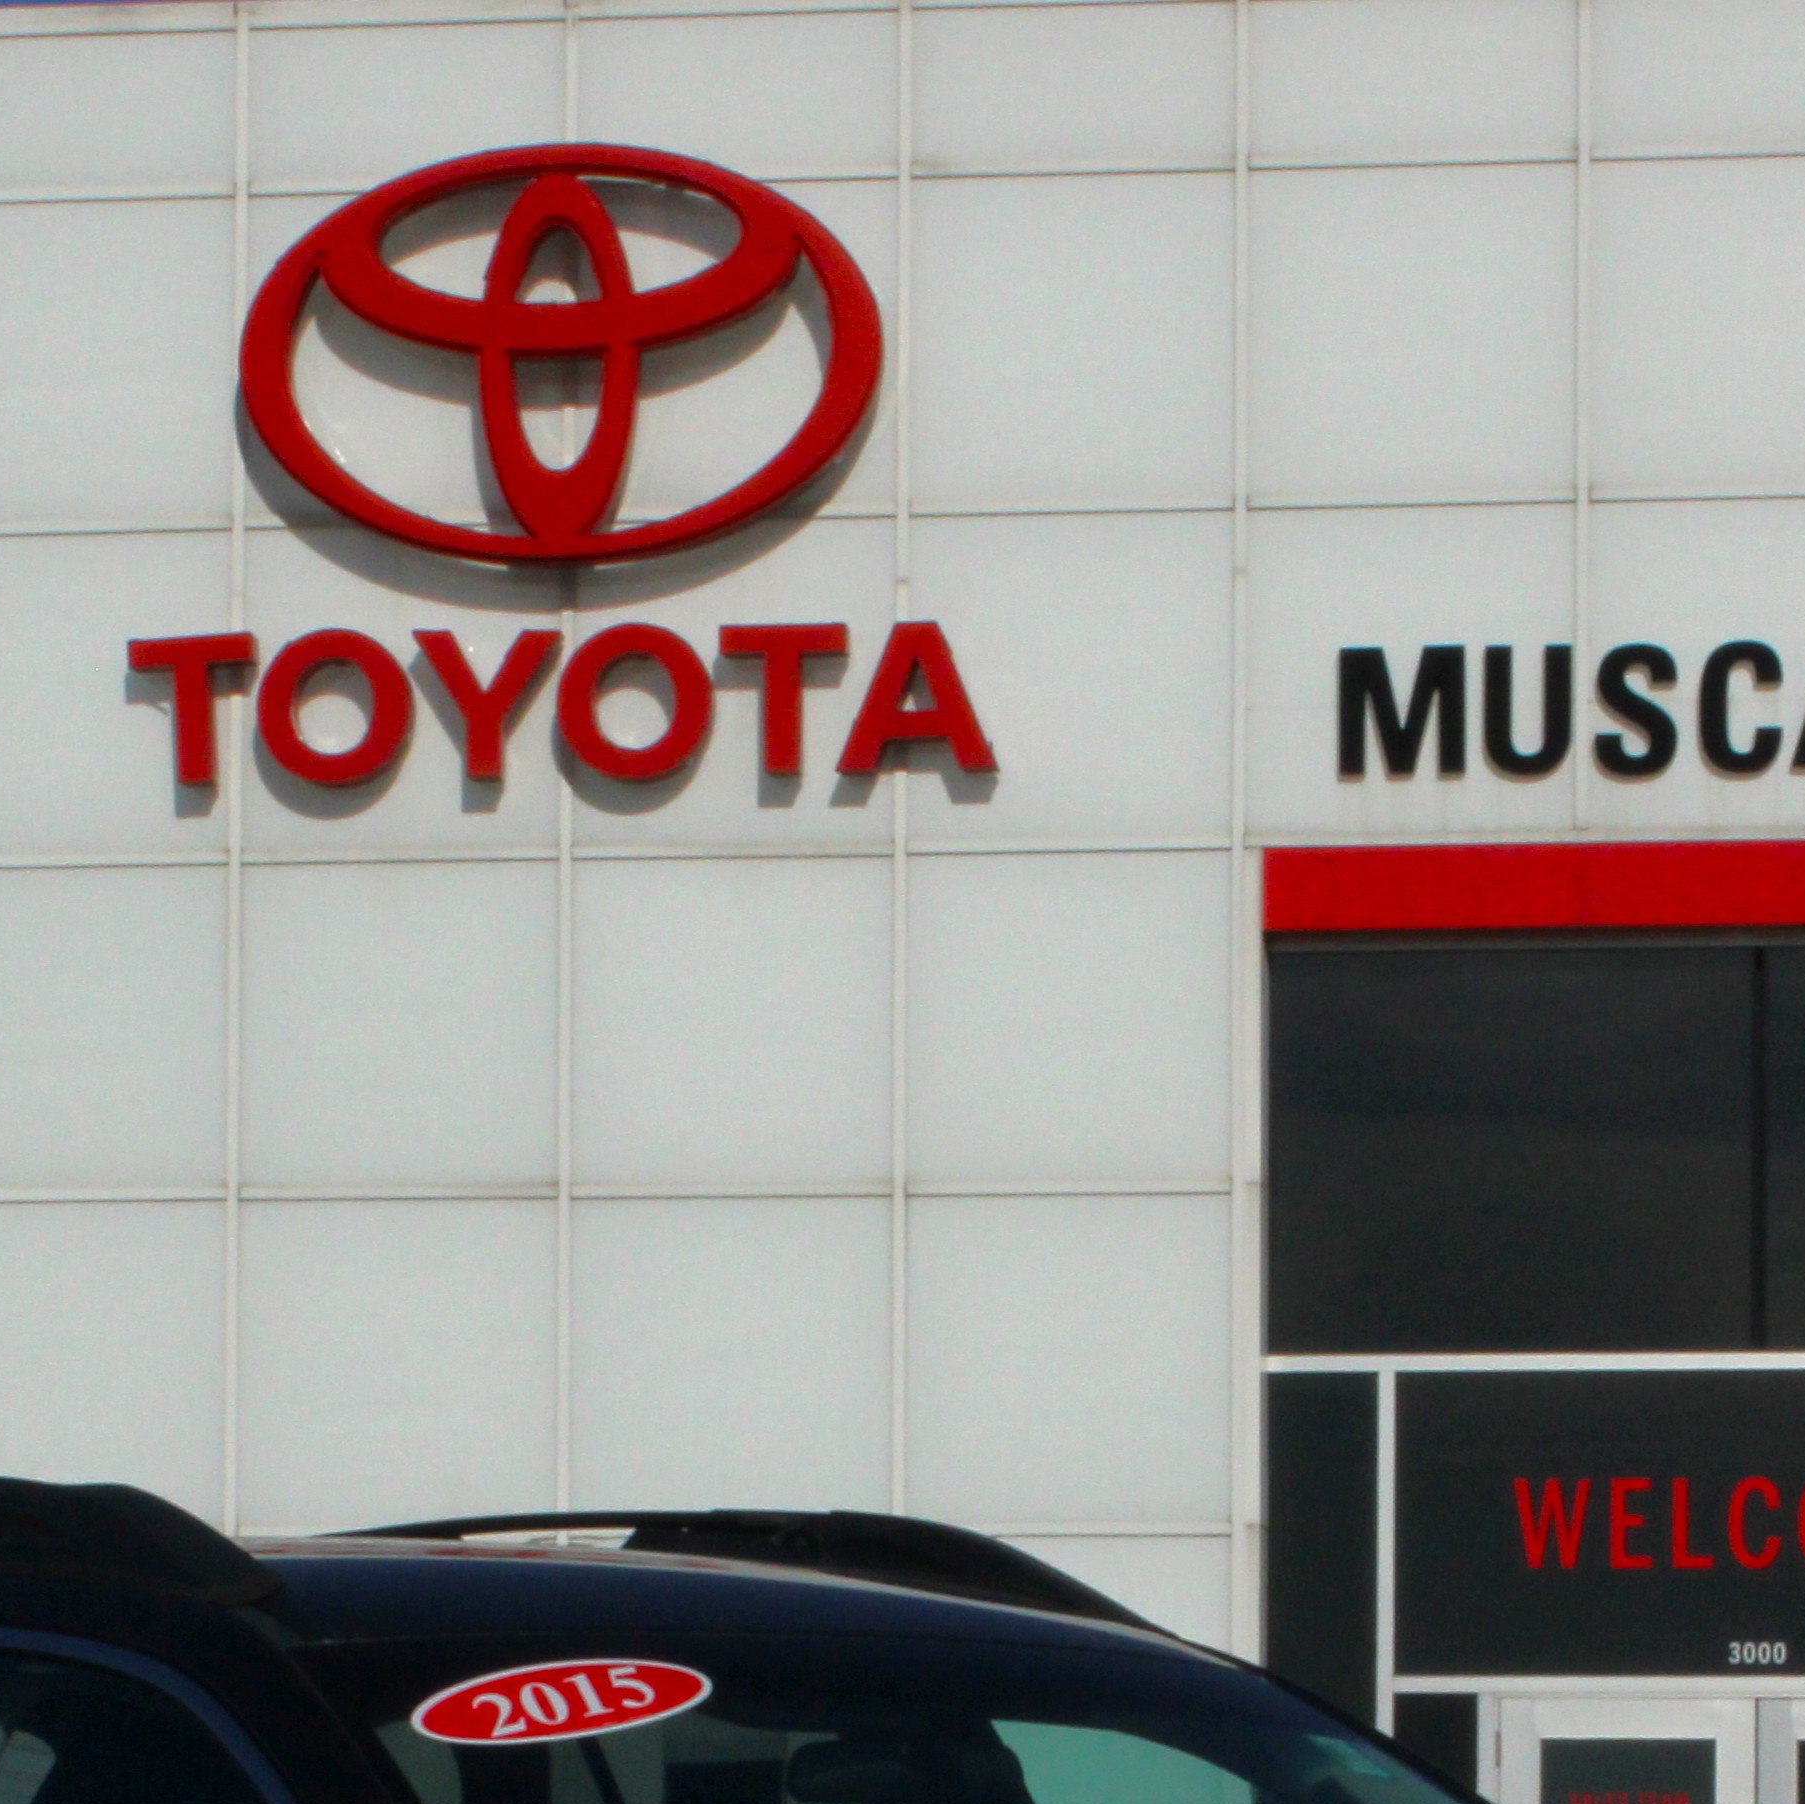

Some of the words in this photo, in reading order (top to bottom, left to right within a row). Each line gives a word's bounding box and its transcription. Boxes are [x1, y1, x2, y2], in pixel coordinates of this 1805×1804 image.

[127, 620, 998, 788] TOYOTA
[1727, 1641, 1787, 1665] 3000
[471, 1665, 656, 1739] 2015
